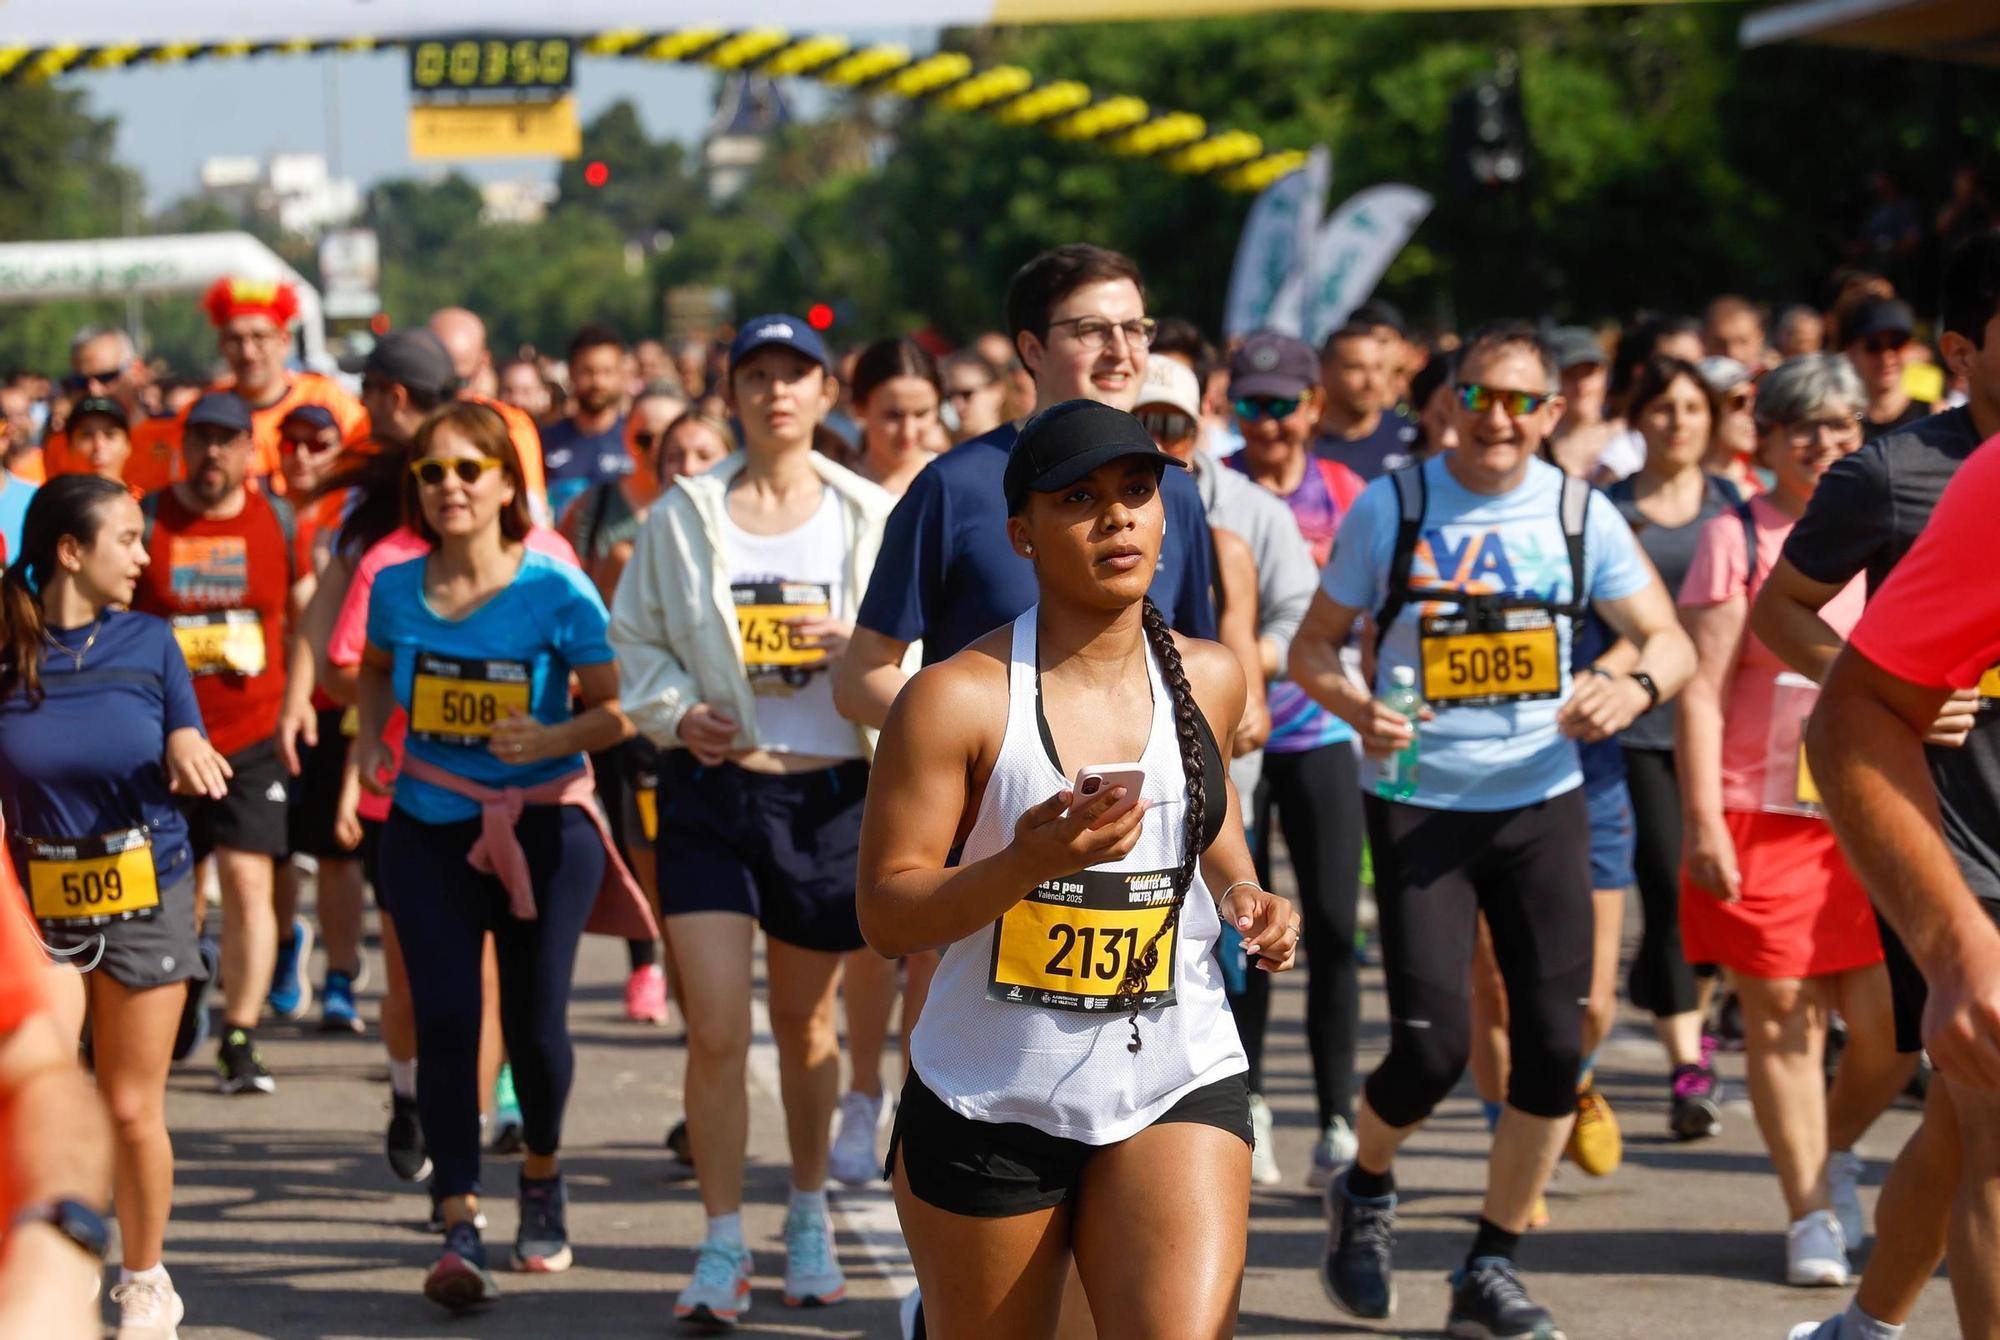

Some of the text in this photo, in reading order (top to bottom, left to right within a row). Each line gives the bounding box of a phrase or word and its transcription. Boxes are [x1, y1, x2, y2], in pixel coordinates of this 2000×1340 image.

[1448, 644, 1533, 686] 5085
[443, 690, 497, 727] 508
[61, 867, 123, 907] 509
[1052, 881, 1060, 891] a
[1062, 882, 1084, 894] peu
[1066, 893, 1083, 904] 2025
[1129, 890, 1152, 903] VOLTES
[1044, 923, 1139, 980] 2131
